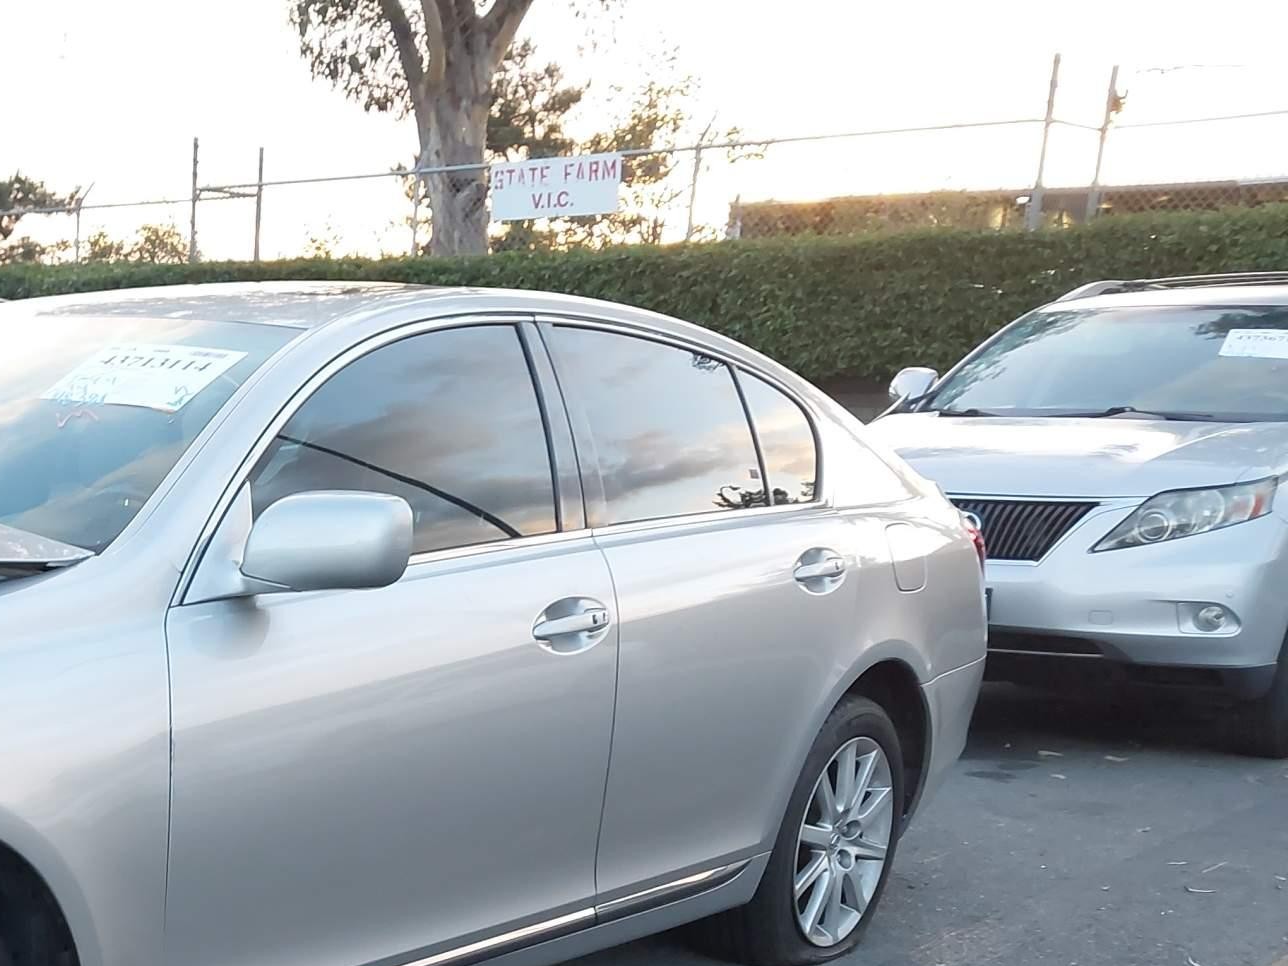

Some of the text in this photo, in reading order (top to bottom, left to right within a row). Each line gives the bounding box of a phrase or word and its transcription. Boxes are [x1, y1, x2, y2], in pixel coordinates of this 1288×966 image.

[494, 159, 617, 190] STATE FARM
[531, 191, 574, 209] V.I.C.
